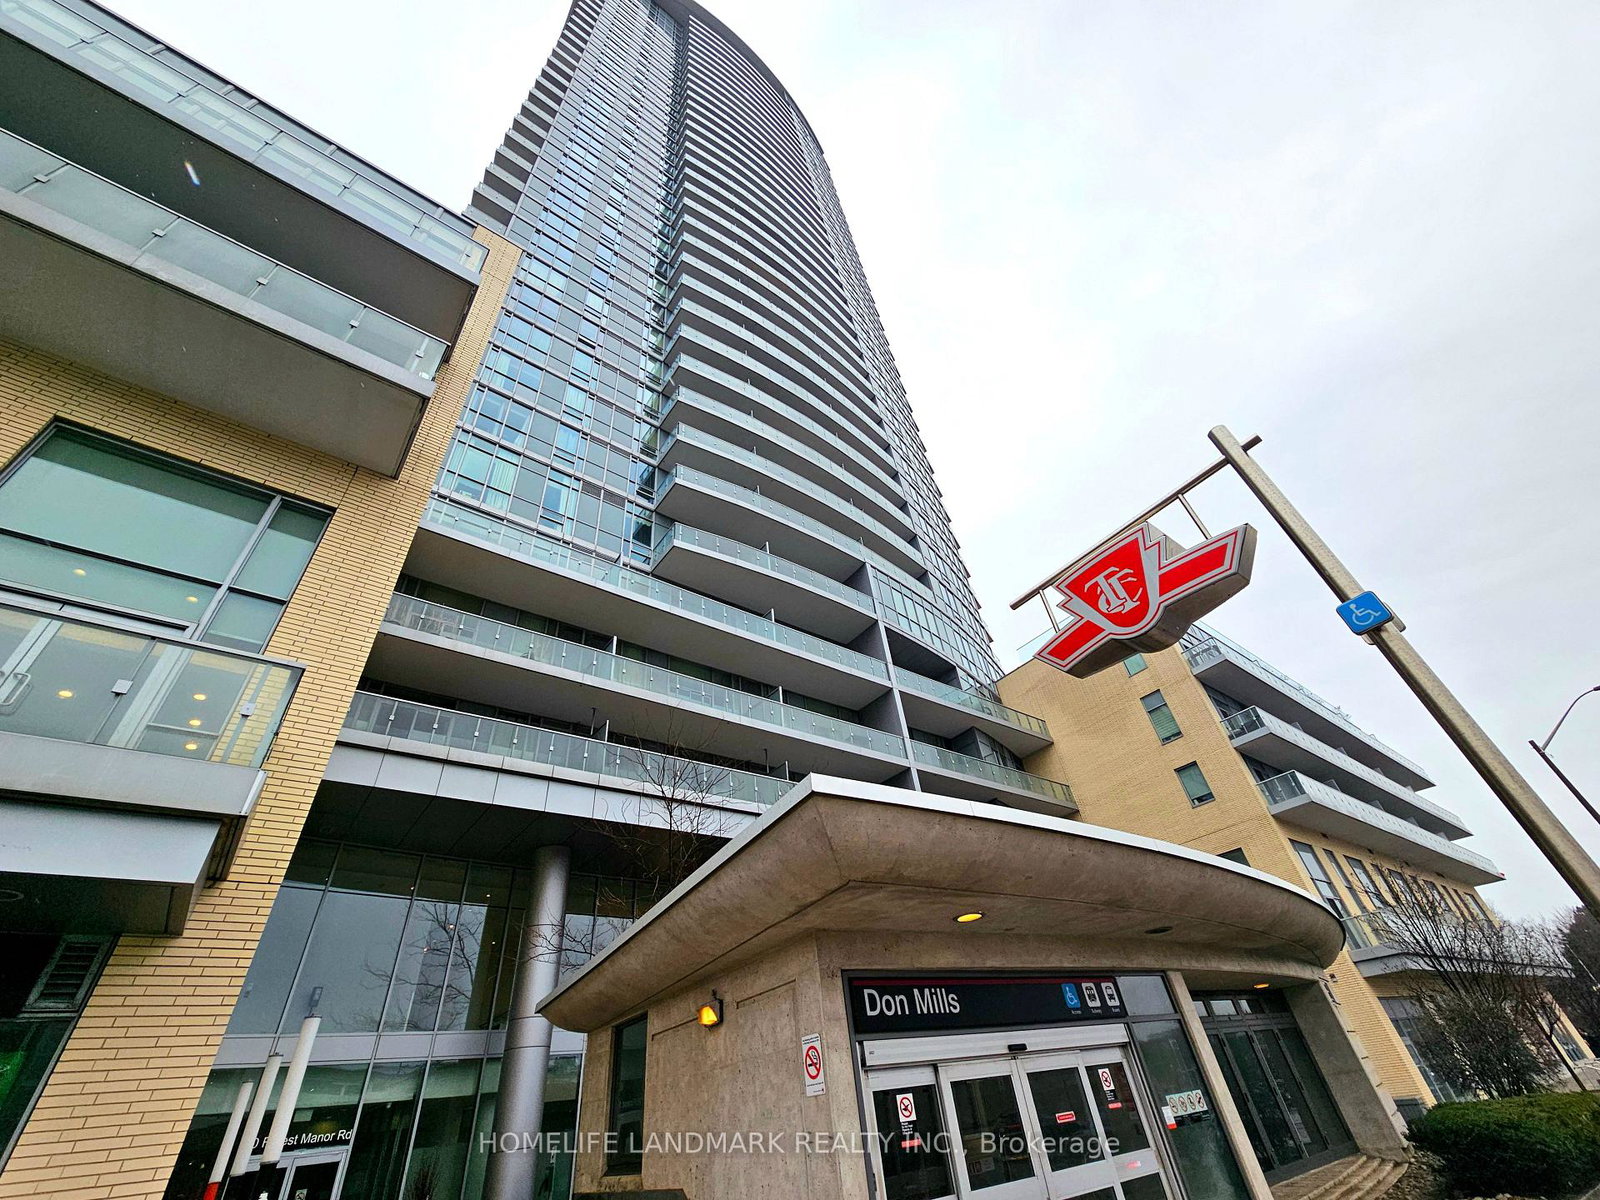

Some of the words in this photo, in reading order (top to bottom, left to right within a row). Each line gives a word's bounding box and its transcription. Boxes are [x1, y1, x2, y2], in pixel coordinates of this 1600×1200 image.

[863, 988, 909, 1016] Don
[913, 987, 960, 1014] Mills
[261, 1134, 298, 1149] Fest
[300, 1132, 335, 1144] Manor
[336, 1129, 353, 1140] Rd
